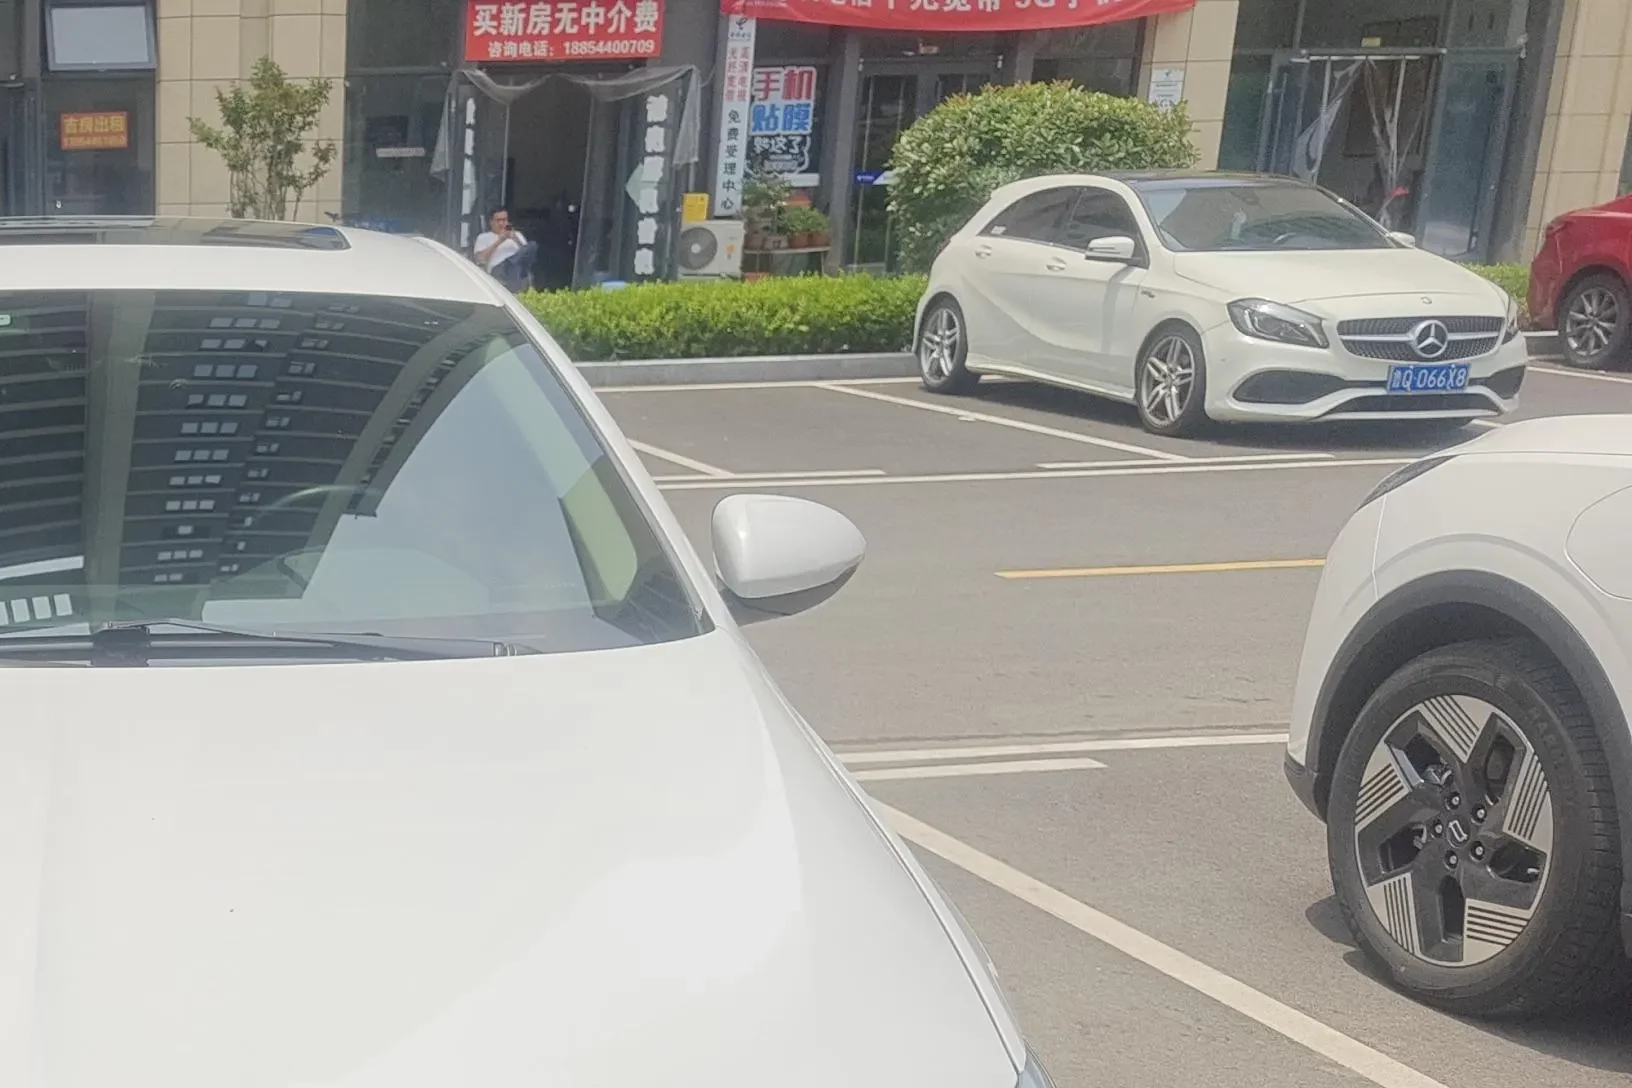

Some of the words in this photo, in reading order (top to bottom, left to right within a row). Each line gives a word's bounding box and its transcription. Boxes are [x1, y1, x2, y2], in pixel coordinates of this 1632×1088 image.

[472, 1, 660, 36] 买新房无中介费
[754, 69, 815, 100] 手机
[751, 103, 811, 132] 贴膜
[720, 109, 741, 210] 免费受理中心
